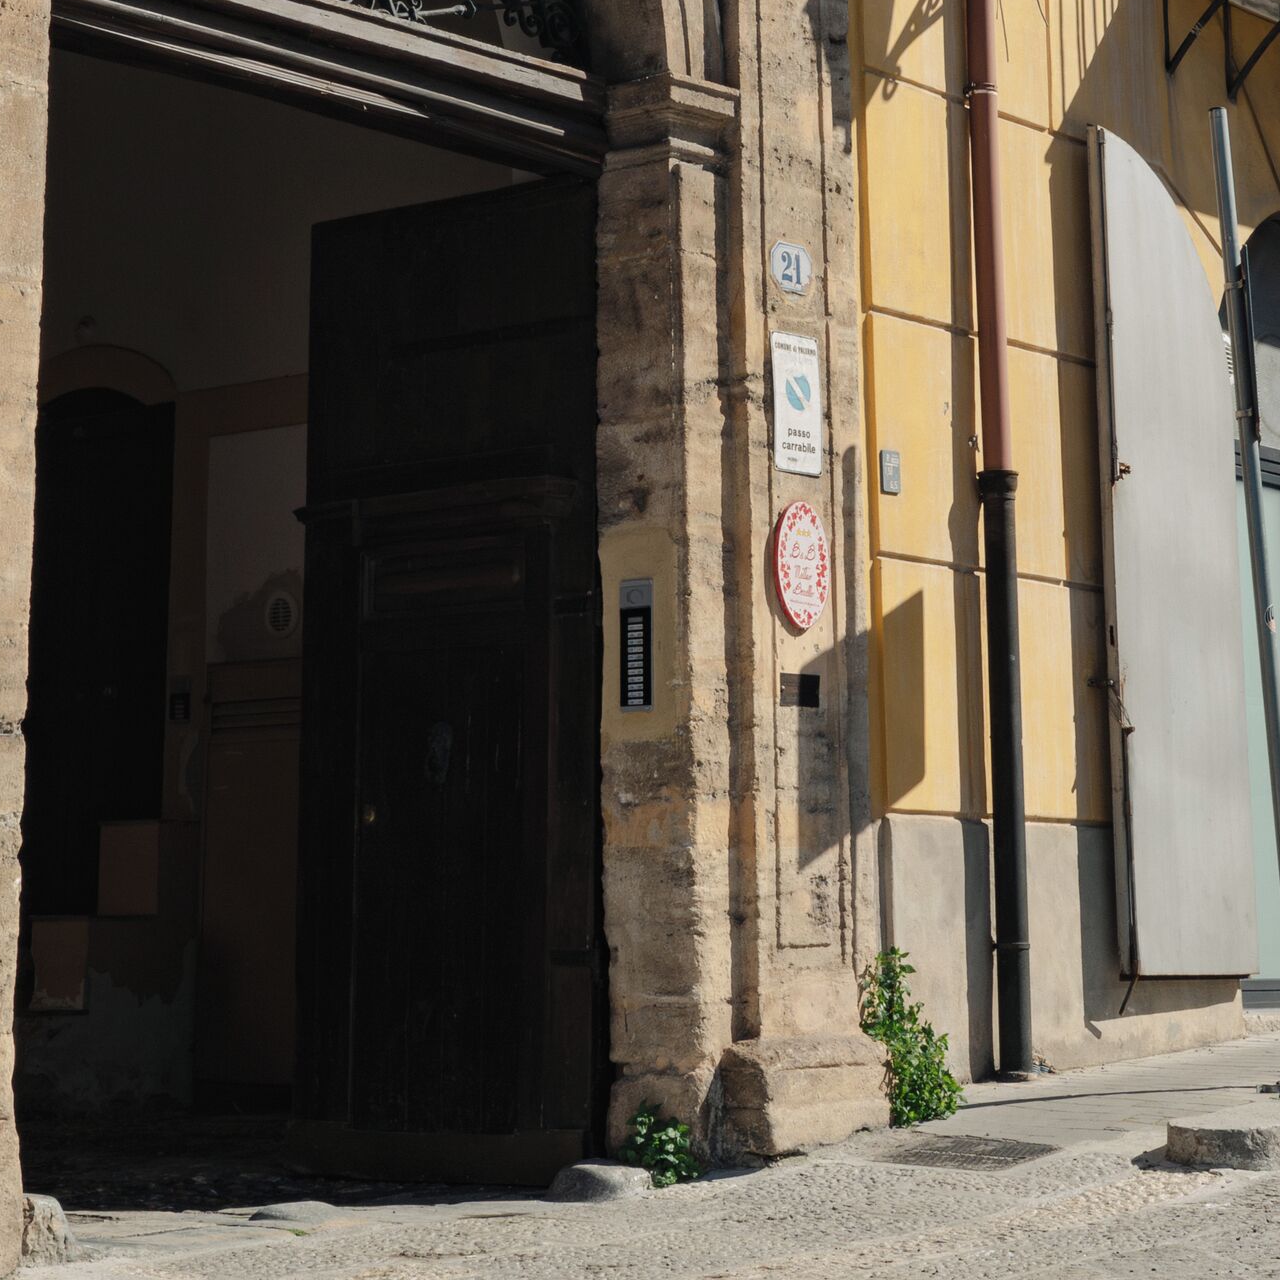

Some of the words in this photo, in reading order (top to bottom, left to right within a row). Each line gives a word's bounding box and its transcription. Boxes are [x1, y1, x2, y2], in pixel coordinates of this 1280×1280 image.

[781, 251, 801, 285] 21
[787, 427, 811, 439] passo
[781, 441, 816, 454] carrabile
